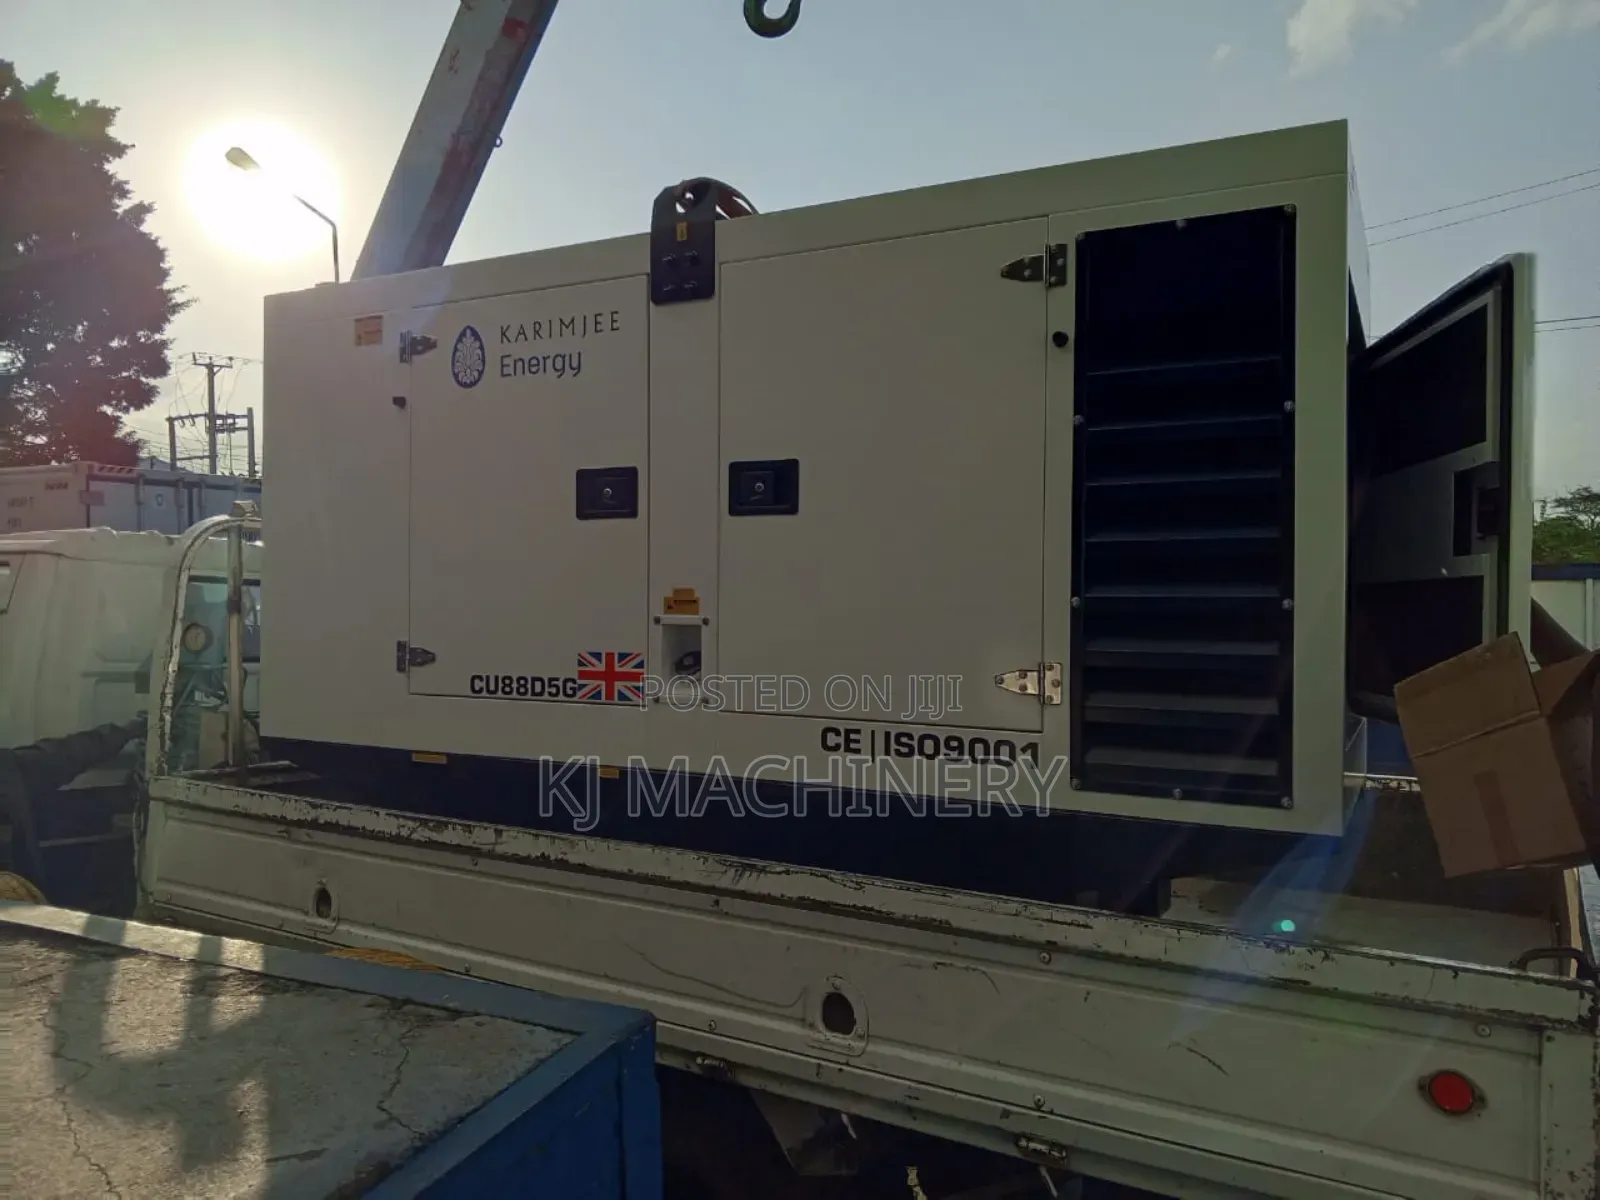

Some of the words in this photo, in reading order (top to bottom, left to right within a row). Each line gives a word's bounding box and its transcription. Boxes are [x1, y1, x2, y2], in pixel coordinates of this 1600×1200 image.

[500, 311, 620, 344] KARIMJEE
[500, 351, 582, 379] Energy
[470, 674, 578, 698] CU88D5G
[820, 726, 862, 755] CE
[884, 730, 1041, 770] ISO9001
